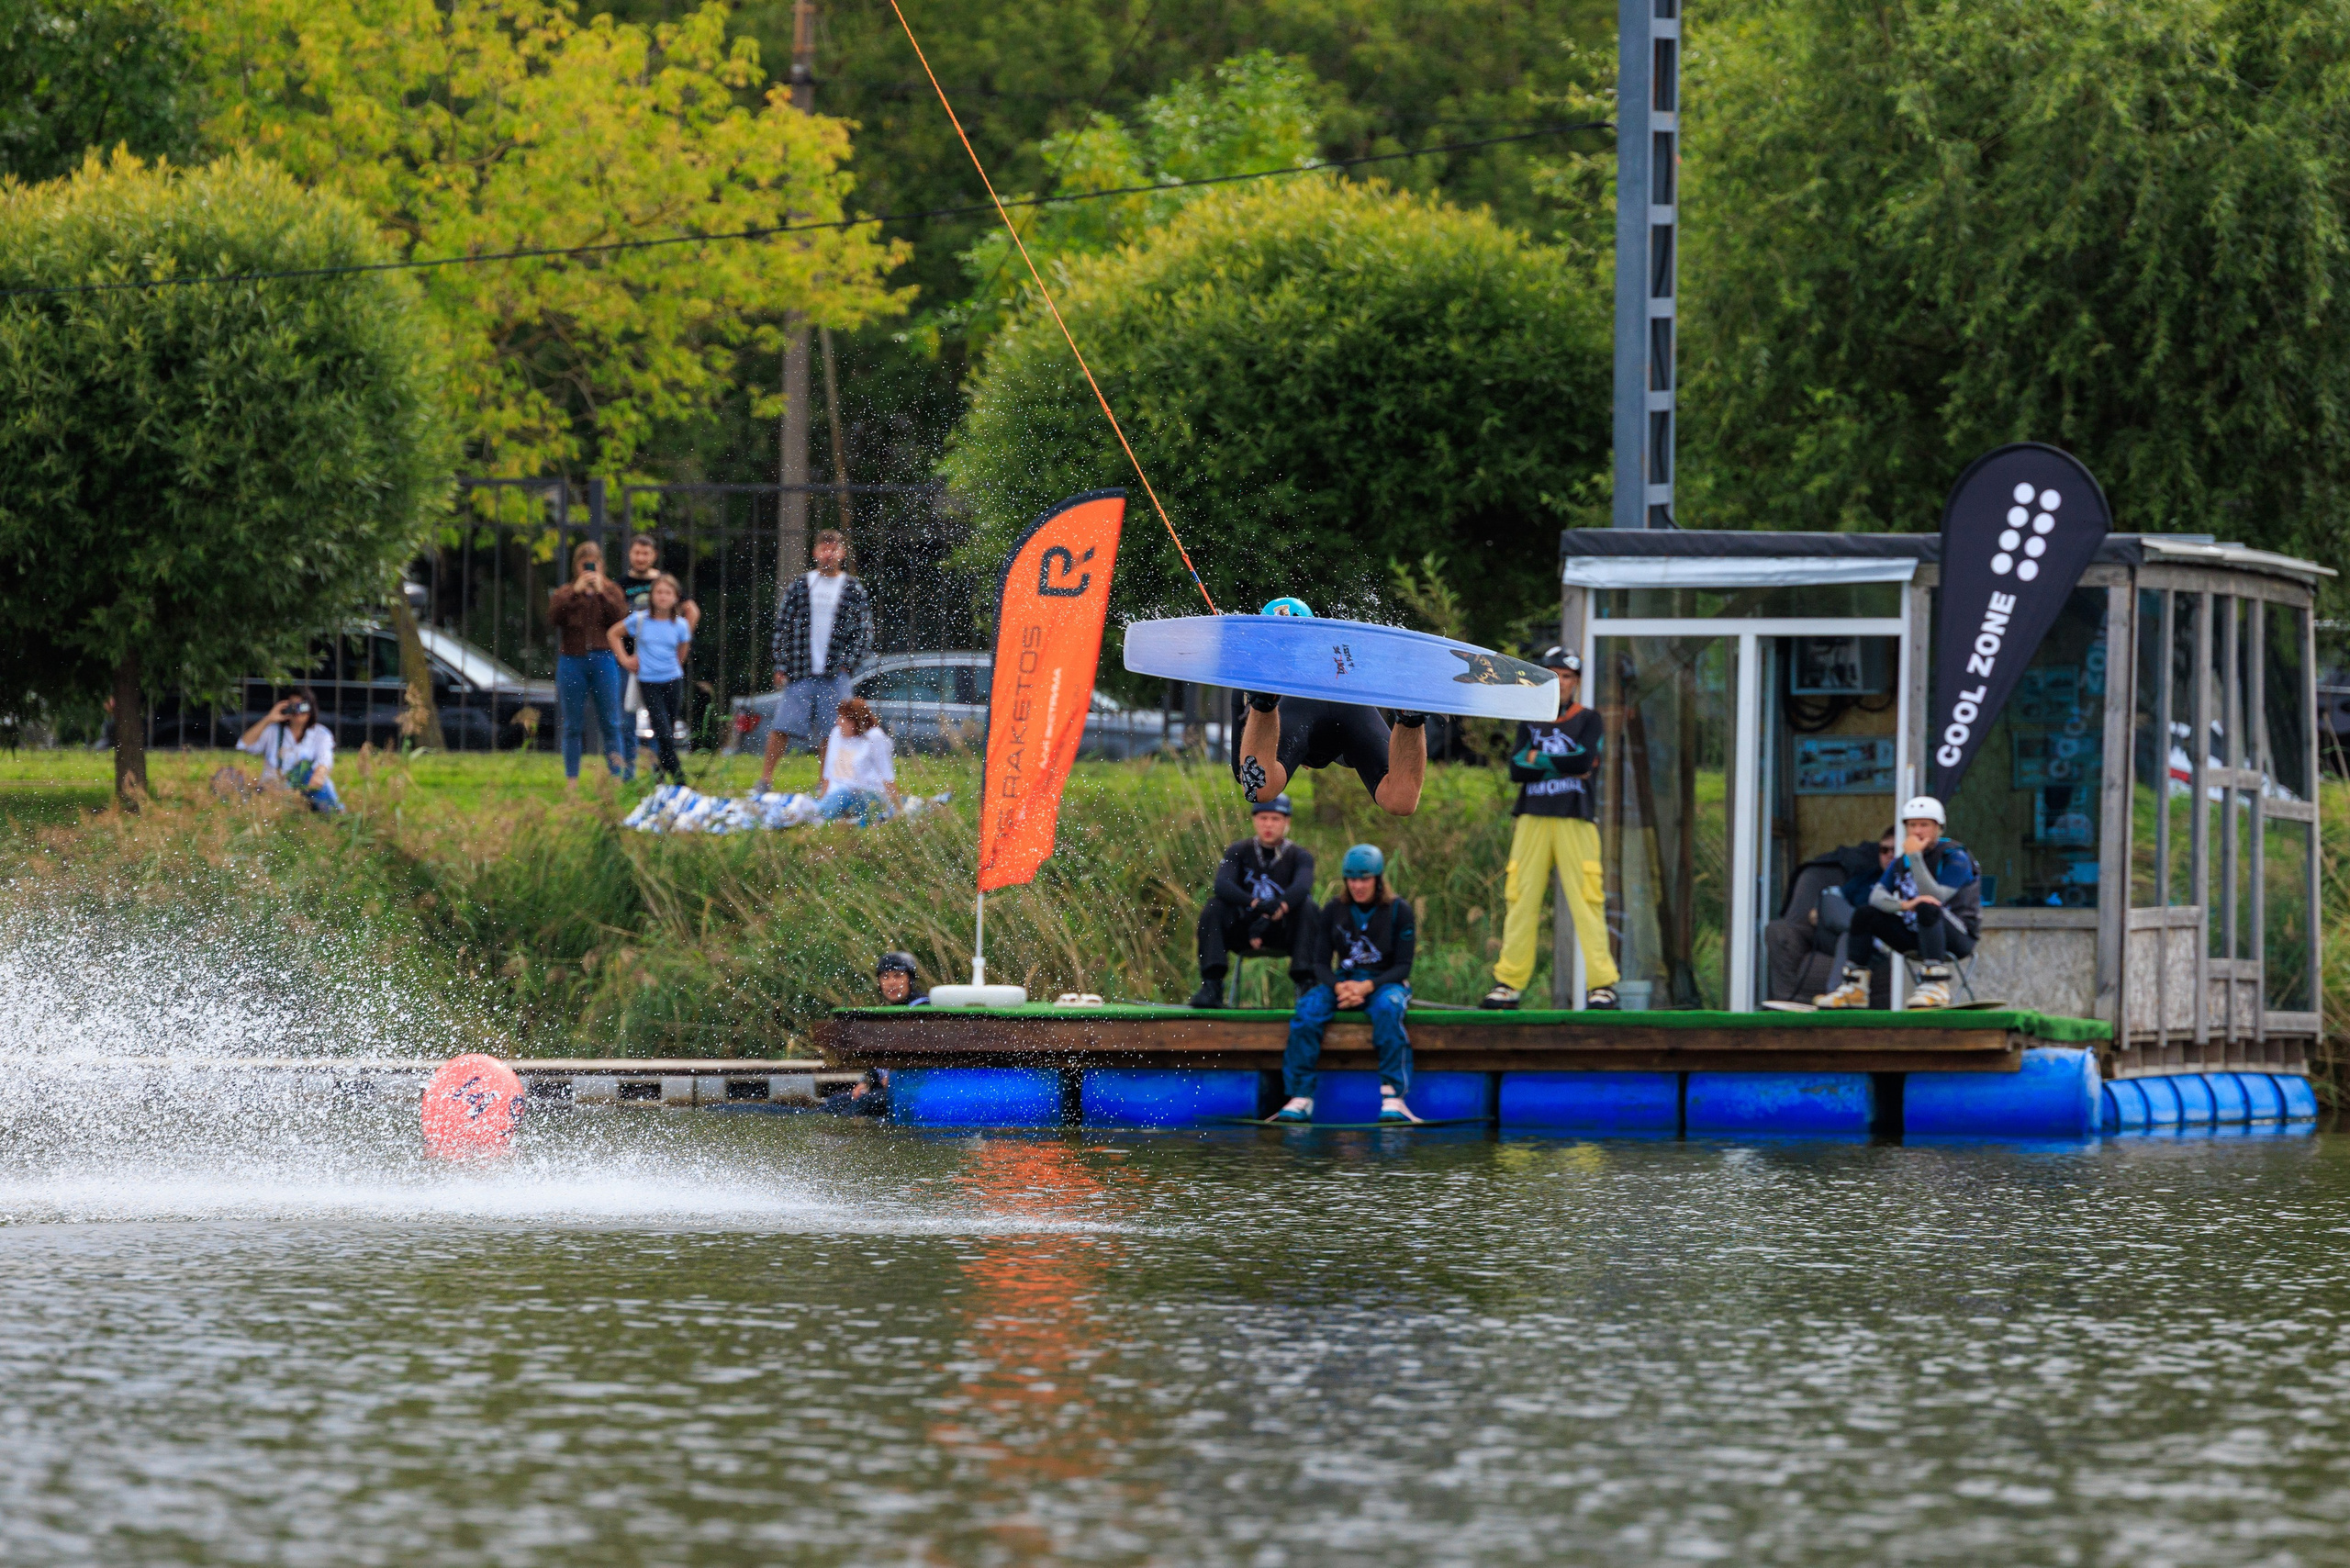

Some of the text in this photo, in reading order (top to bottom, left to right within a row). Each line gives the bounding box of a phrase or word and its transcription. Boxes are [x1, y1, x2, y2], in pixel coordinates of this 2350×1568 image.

[1002, 625, 1042, 799] RAKETOS
[1936, 590, 2018, 767] COOL ZONE
